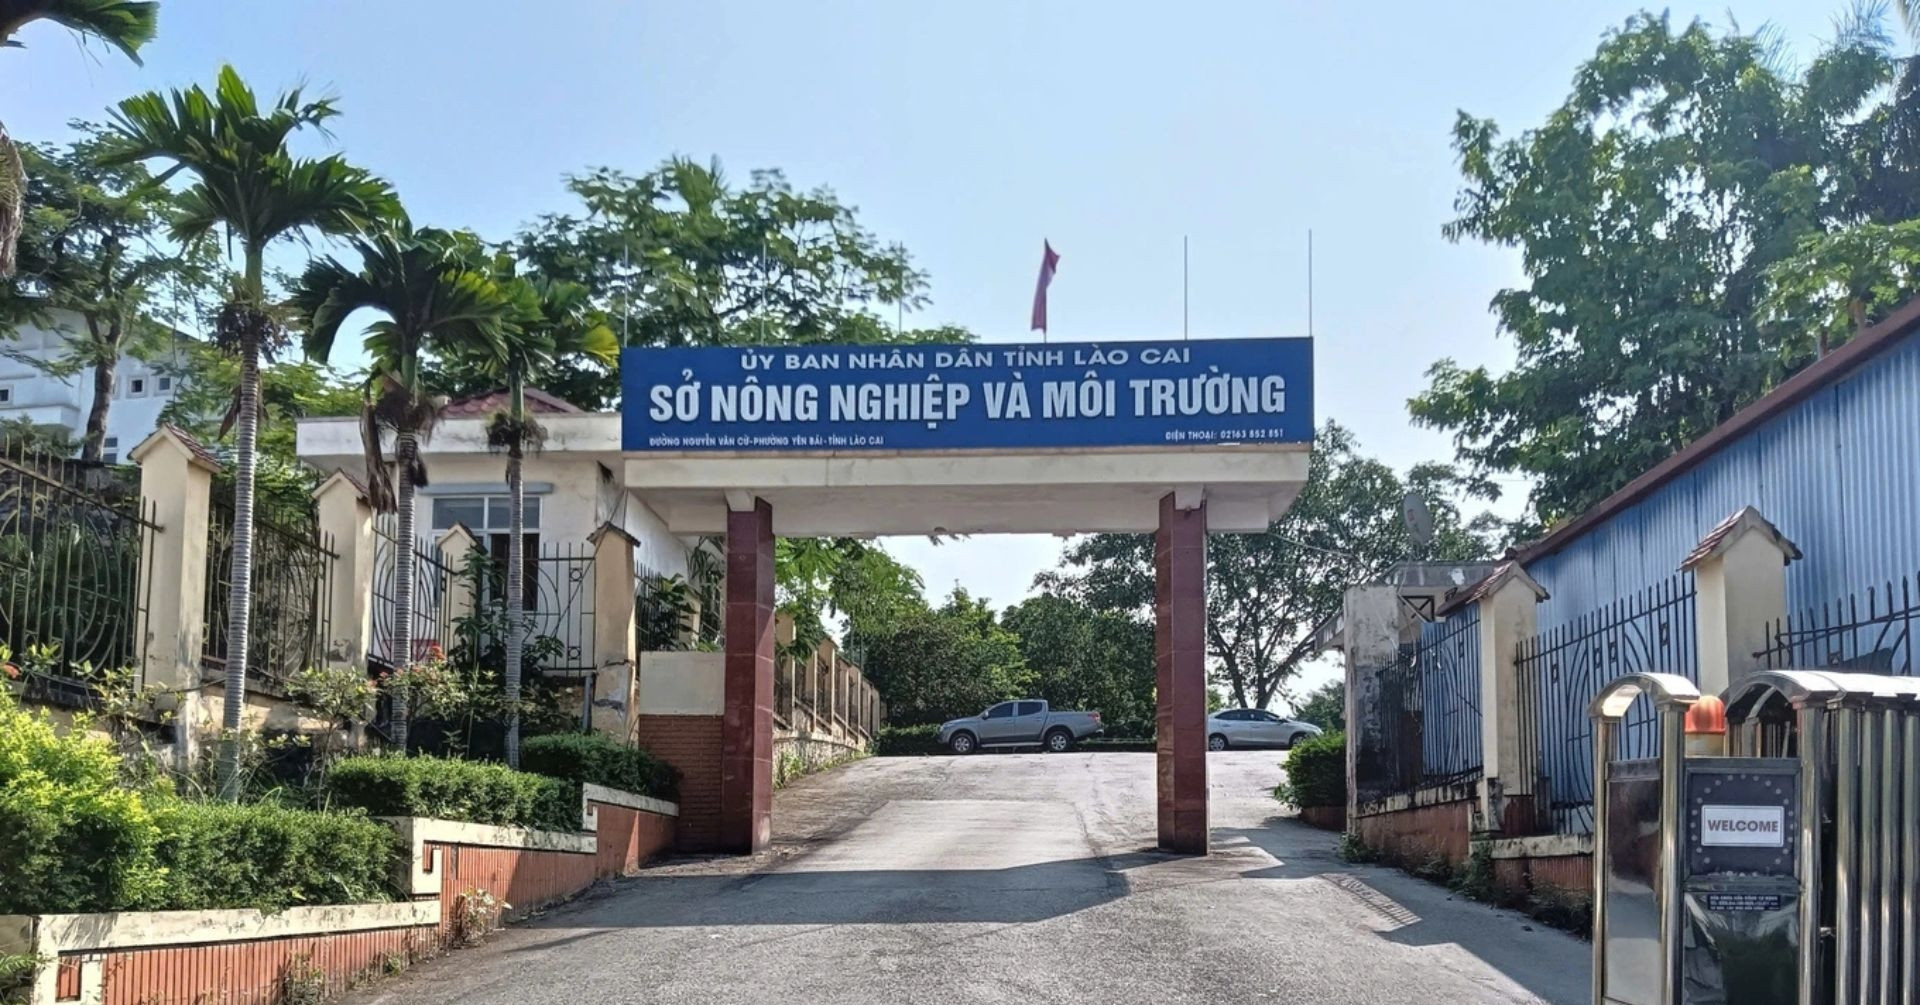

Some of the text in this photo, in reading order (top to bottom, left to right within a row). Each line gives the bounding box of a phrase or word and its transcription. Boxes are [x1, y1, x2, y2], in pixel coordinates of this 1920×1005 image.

[741, 344, 1190, 370] ỦY BAN NHÂN DÂN TỈNH LÀO CAI
[650, 365, 1286, 428] SỞ NÔNG NGHIỆP VÀ MÔI TRƯỜNG
[649, 433, 680, 446] ĐƯỜNG
[791, 434, 807, 446] YÊN
[849, 434, 866, 446] LÀO
[869, 435, 884, 445] CAI
[1165, 430, 1185, 442] ĐIỆN
[1707, 818, 1779, 833] WELCOME
